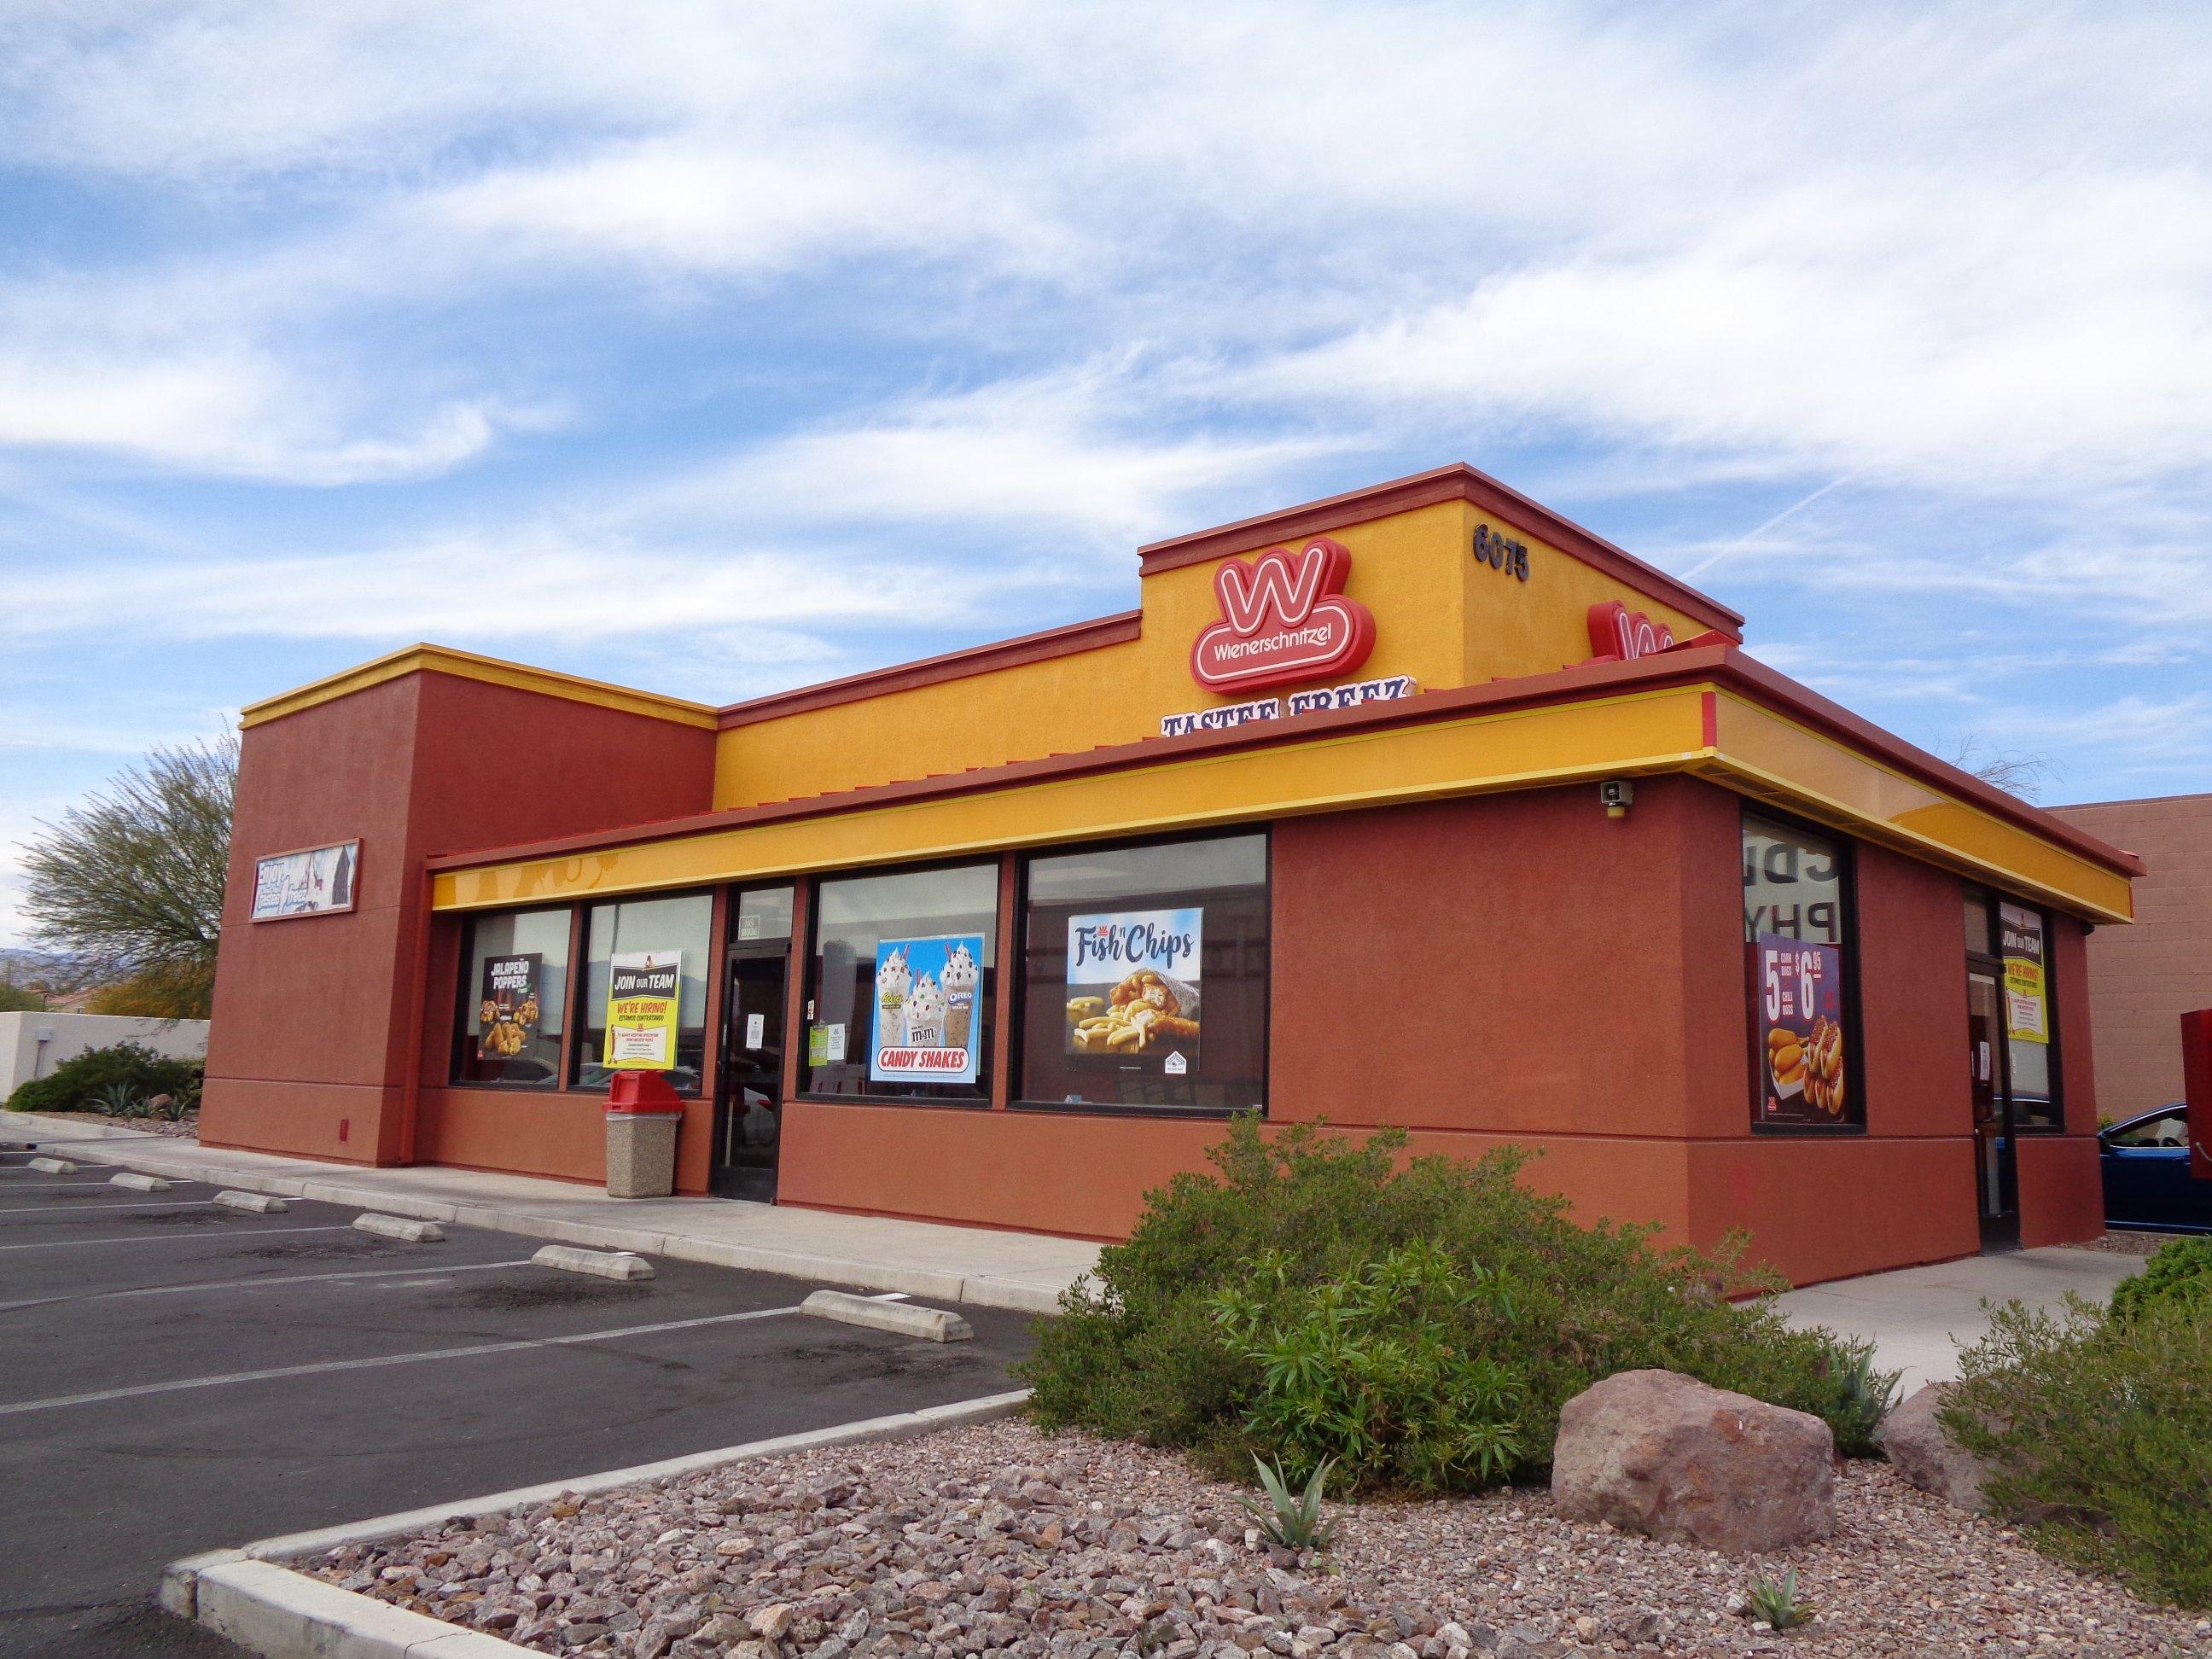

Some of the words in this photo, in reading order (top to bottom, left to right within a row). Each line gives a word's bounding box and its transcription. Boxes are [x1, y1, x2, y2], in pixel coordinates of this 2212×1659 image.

[1474, 523, 1530, 582] 6075
[1220, 547, 1324, 633] W
[1214, 622, 1332, 662] Wienerschnitzel
[1075, 924, 1123, 967] Fish
[1126, 923, 1194, 969] Chips
[2024, 935, 2040, 955] TEAM
[491, 958, 529, 976] JALAPEÑO
[492, 975, 527, 989] POPPERS
[614, 975, 637, 990] JOIN
[636, 978, 649, 988] OUR
[649, 974, 675, 989] TEAM
[1766, 950, 1780, 1022] 5
[949, 991, 973, 1002] OREO
[617, 1001, 640, 1015] WE'RE
[640, 1001, 668, 1014] HIRING!
[881, 1051, 918, 1068] CANDY
[918, 1051, 965, 1068] SHAKES
